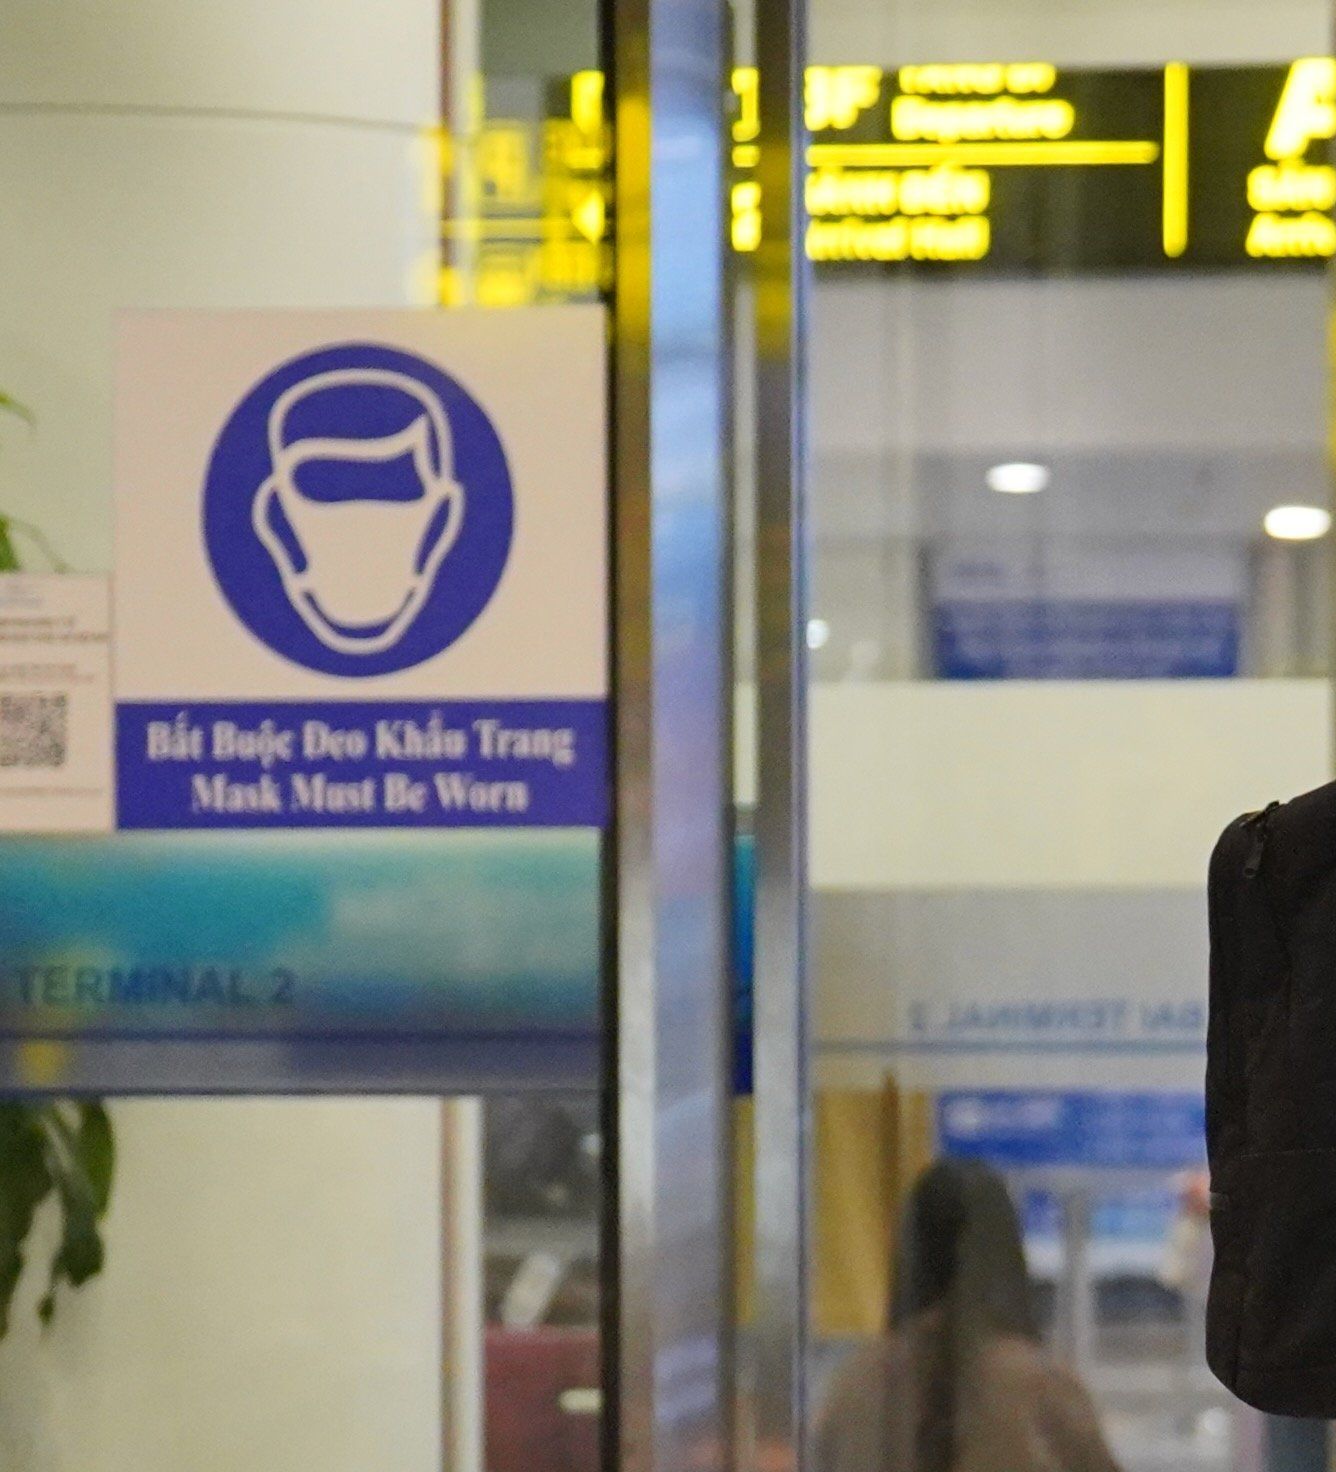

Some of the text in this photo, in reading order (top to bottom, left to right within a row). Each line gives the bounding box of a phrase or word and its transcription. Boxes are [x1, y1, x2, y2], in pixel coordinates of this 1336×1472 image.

[471, 718, 575, 770] Trang
[191, 772, 530, 814] Mask Must Be Worn
[20, 964, 297, 1004] TERMINAL 2
